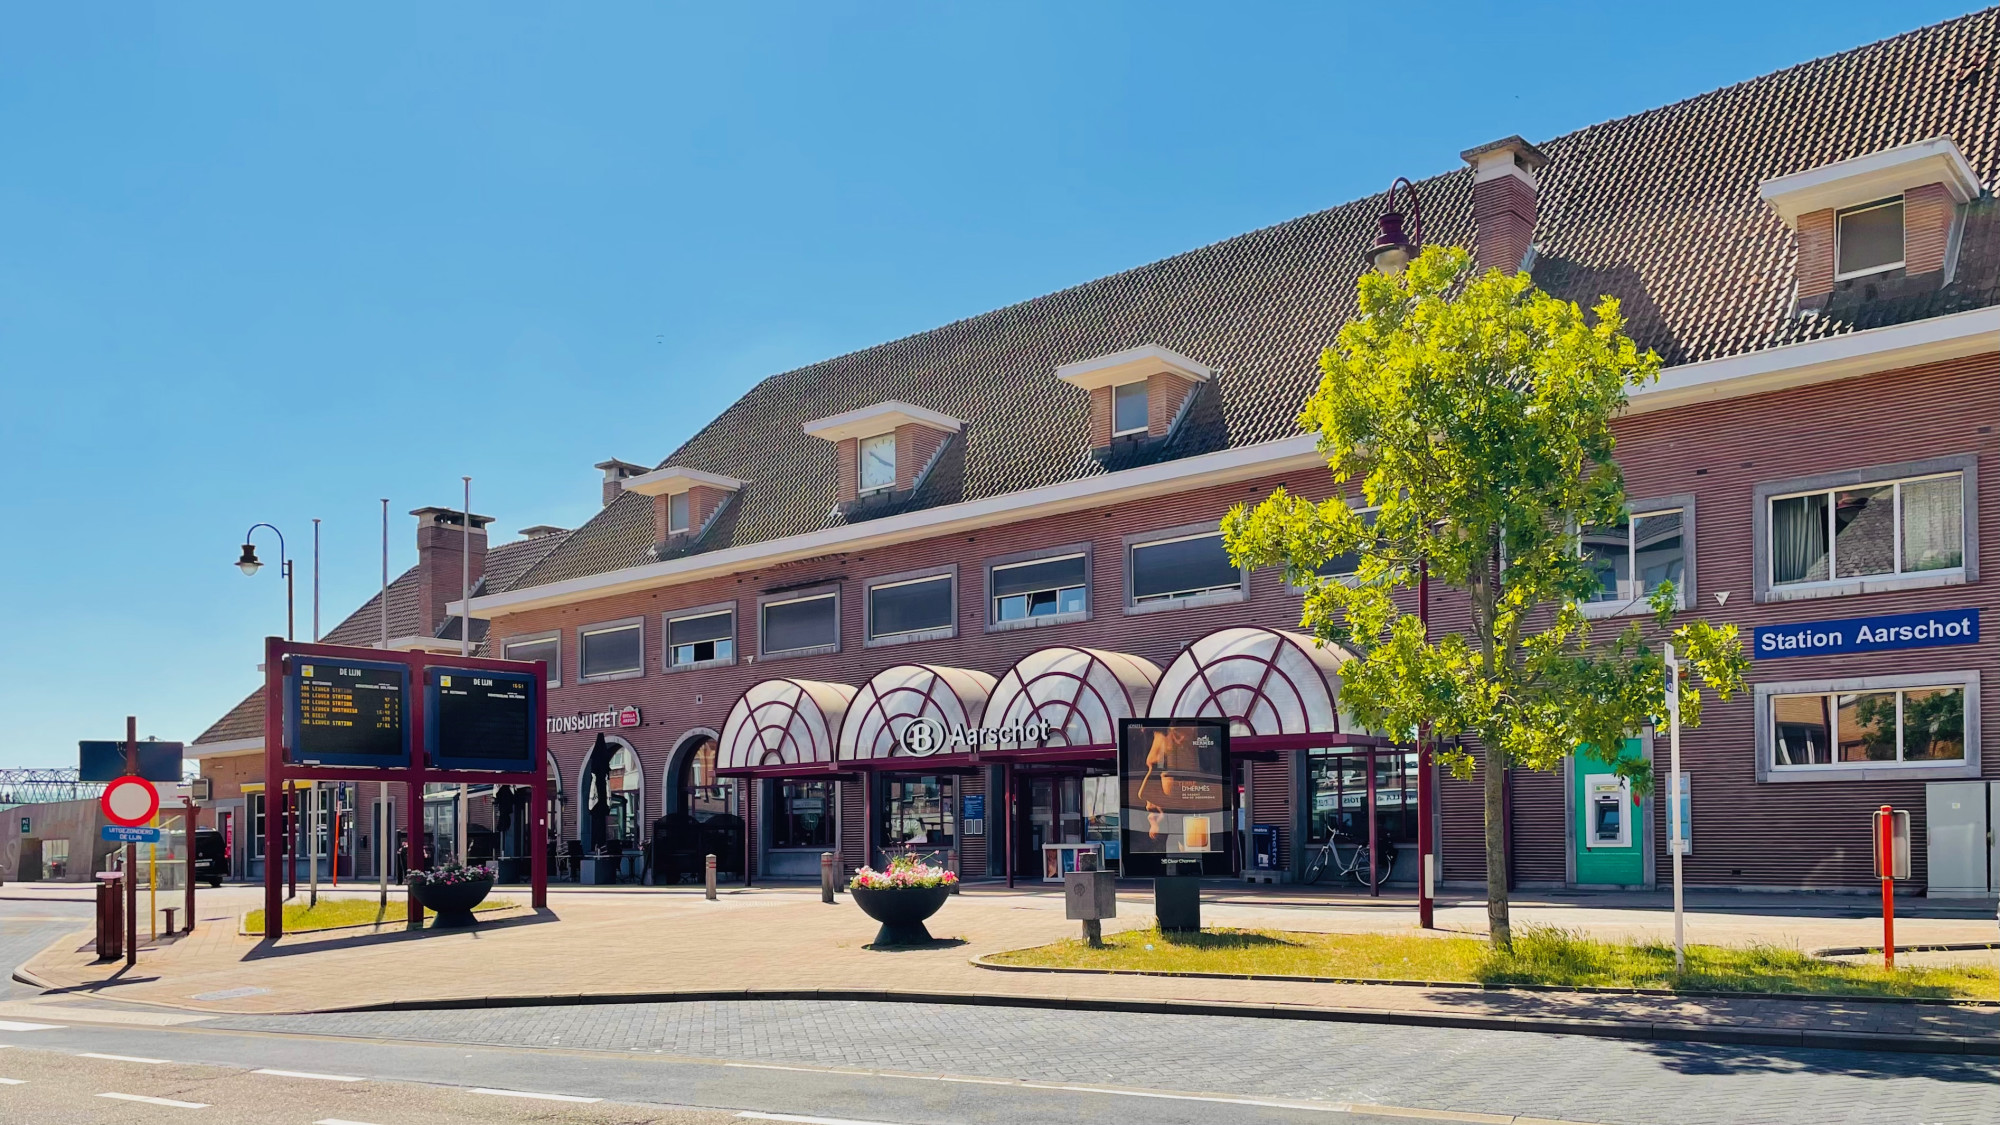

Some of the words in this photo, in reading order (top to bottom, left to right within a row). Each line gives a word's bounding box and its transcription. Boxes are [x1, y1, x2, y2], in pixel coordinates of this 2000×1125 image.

[1761, 630, 1843, 651] Station
[1855, 617, 1971, 644] Aarschot
[339, 668, 348, 676] DE
[348, 668, 361, 677] LIJN
[481, 679, 493, 687] LIJN
[547, 711, 618, 733] TIONSBUFFET
[950, 718, 1050, 746] Aarschot
[108, 827, 154, 836] UITGEZONDERD
